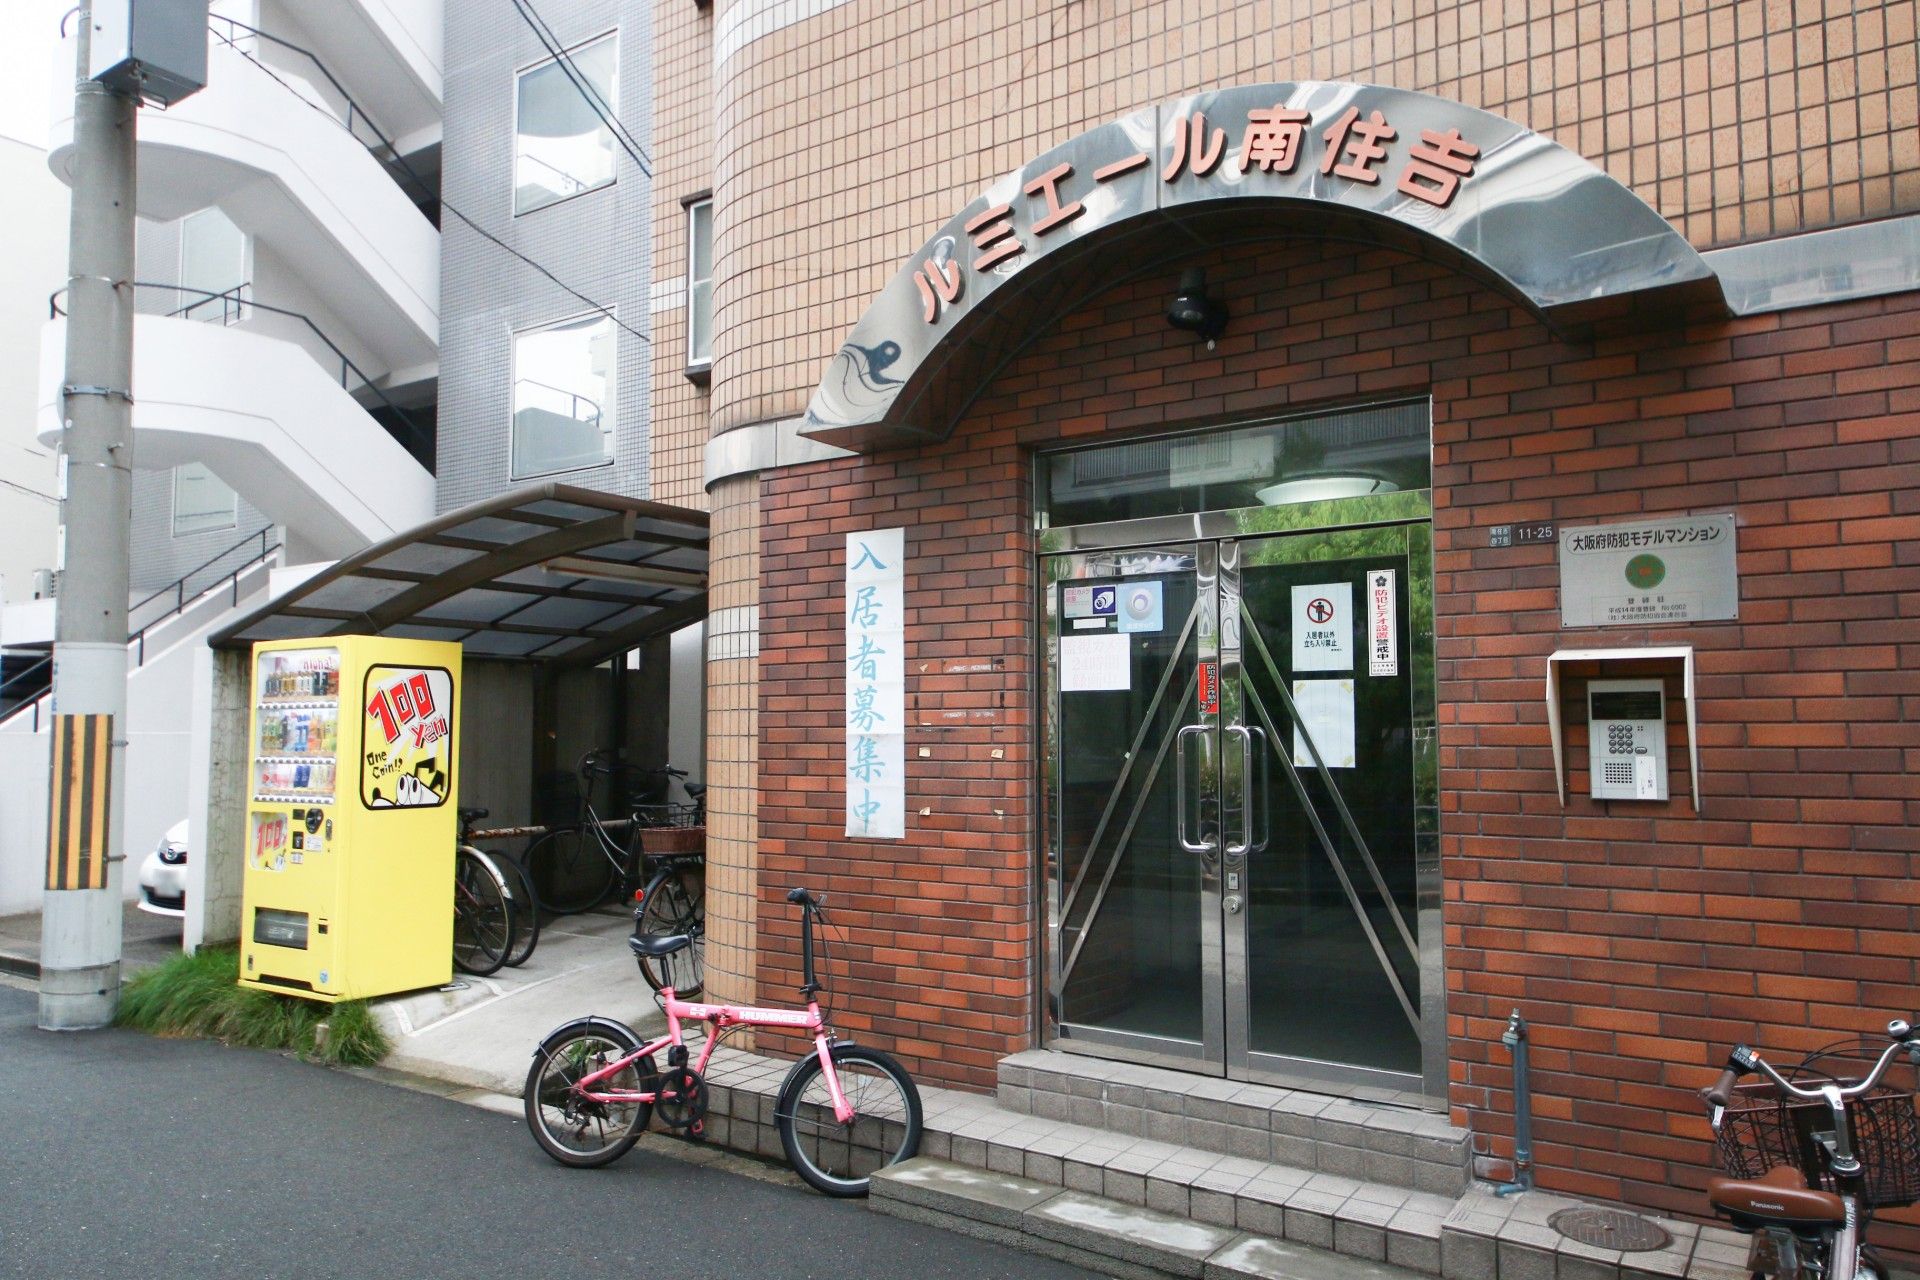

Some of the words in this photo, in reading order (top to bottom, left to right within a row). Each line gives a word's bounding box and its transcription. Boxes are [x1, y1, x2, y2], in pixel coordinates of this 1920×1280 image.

[911, 103, 1481, 325] ルミエール南住吉
[1519, 526, 1553, 540] 11-25
[1572, 525, 1721, 552] 大阪府防犯モデルマンション
[1305, 631, 1335, 640] 入居者以外
[1374, 589, 1390, 661] 防犯ビデオ設置警戒中
[847, 541, 888, 834] 入居者募集中
[366, 671, 436, 745] 100
[366, 751, 387, 766] One
[256, 819, 283, 857] 100
[739, 1011, 808, 1025] HUMMER
[1750, 1200, 1785, 1211] Panasonic
